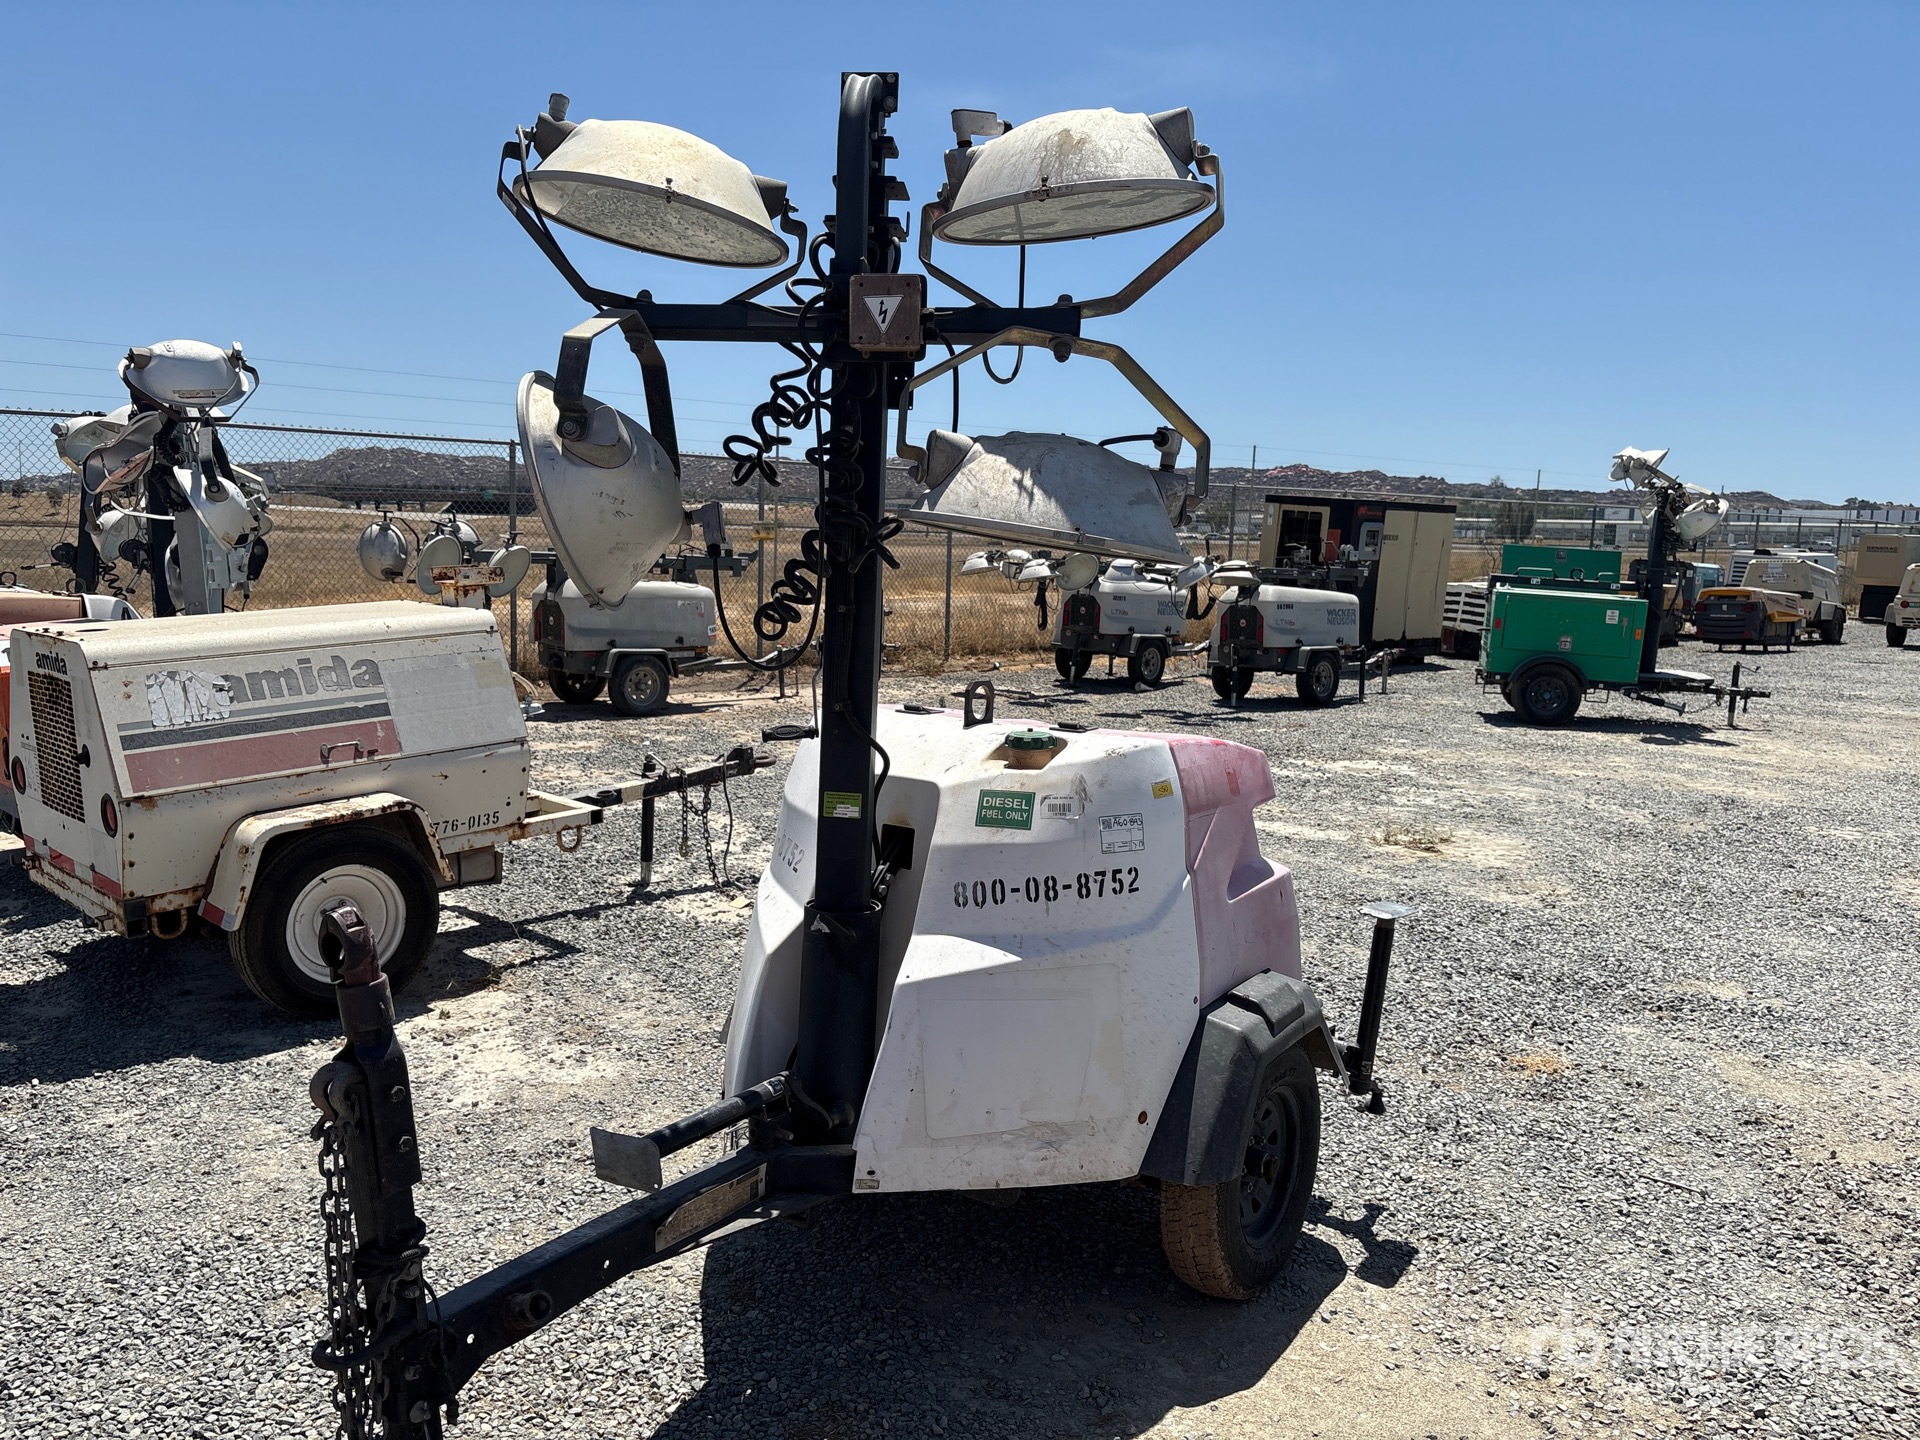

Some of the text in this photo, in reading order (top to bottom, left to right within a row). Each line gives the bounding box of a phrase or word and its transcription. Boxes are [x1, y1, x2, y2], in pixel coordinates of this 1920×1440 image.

[1326, 608, 1357, 617] WACKER
[1326, 617, 1357, 626] NEUSON
[36, 650, 68, 676] amida
[982, 796, 1030, 810] DIESEL
[981, 808, 1029, 821] FUEL ONLY
[432, 810, 500, 834] 776-0135
[953, 866, 1140, 910] 800-08-8752
